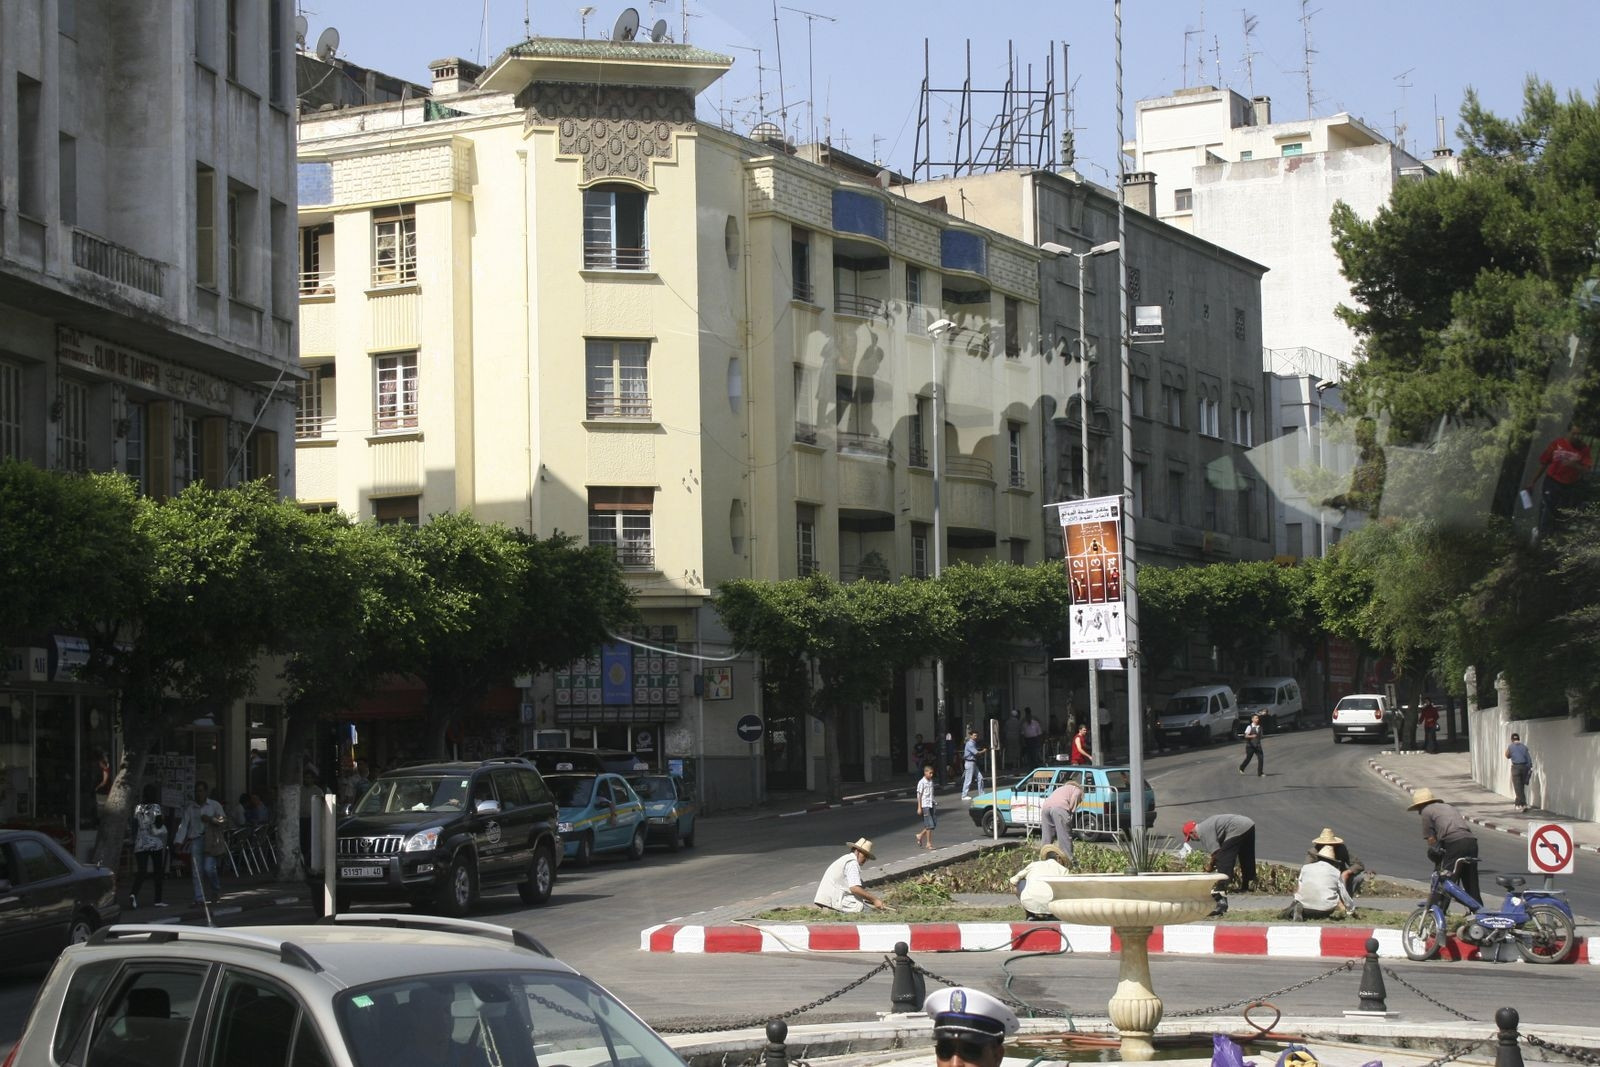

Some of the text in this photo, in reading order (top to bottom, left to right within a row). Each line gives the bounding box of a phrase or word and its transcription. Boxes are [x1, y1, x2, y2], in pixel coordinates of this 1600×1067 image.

[94, 344, 116, 373] CLUB
[117, 351, 129, 377] DE
[1073, 559, 1084, 568] 2
[1090, 558, 1101, 567] 3
[33, 656, 46, 673] Ali
